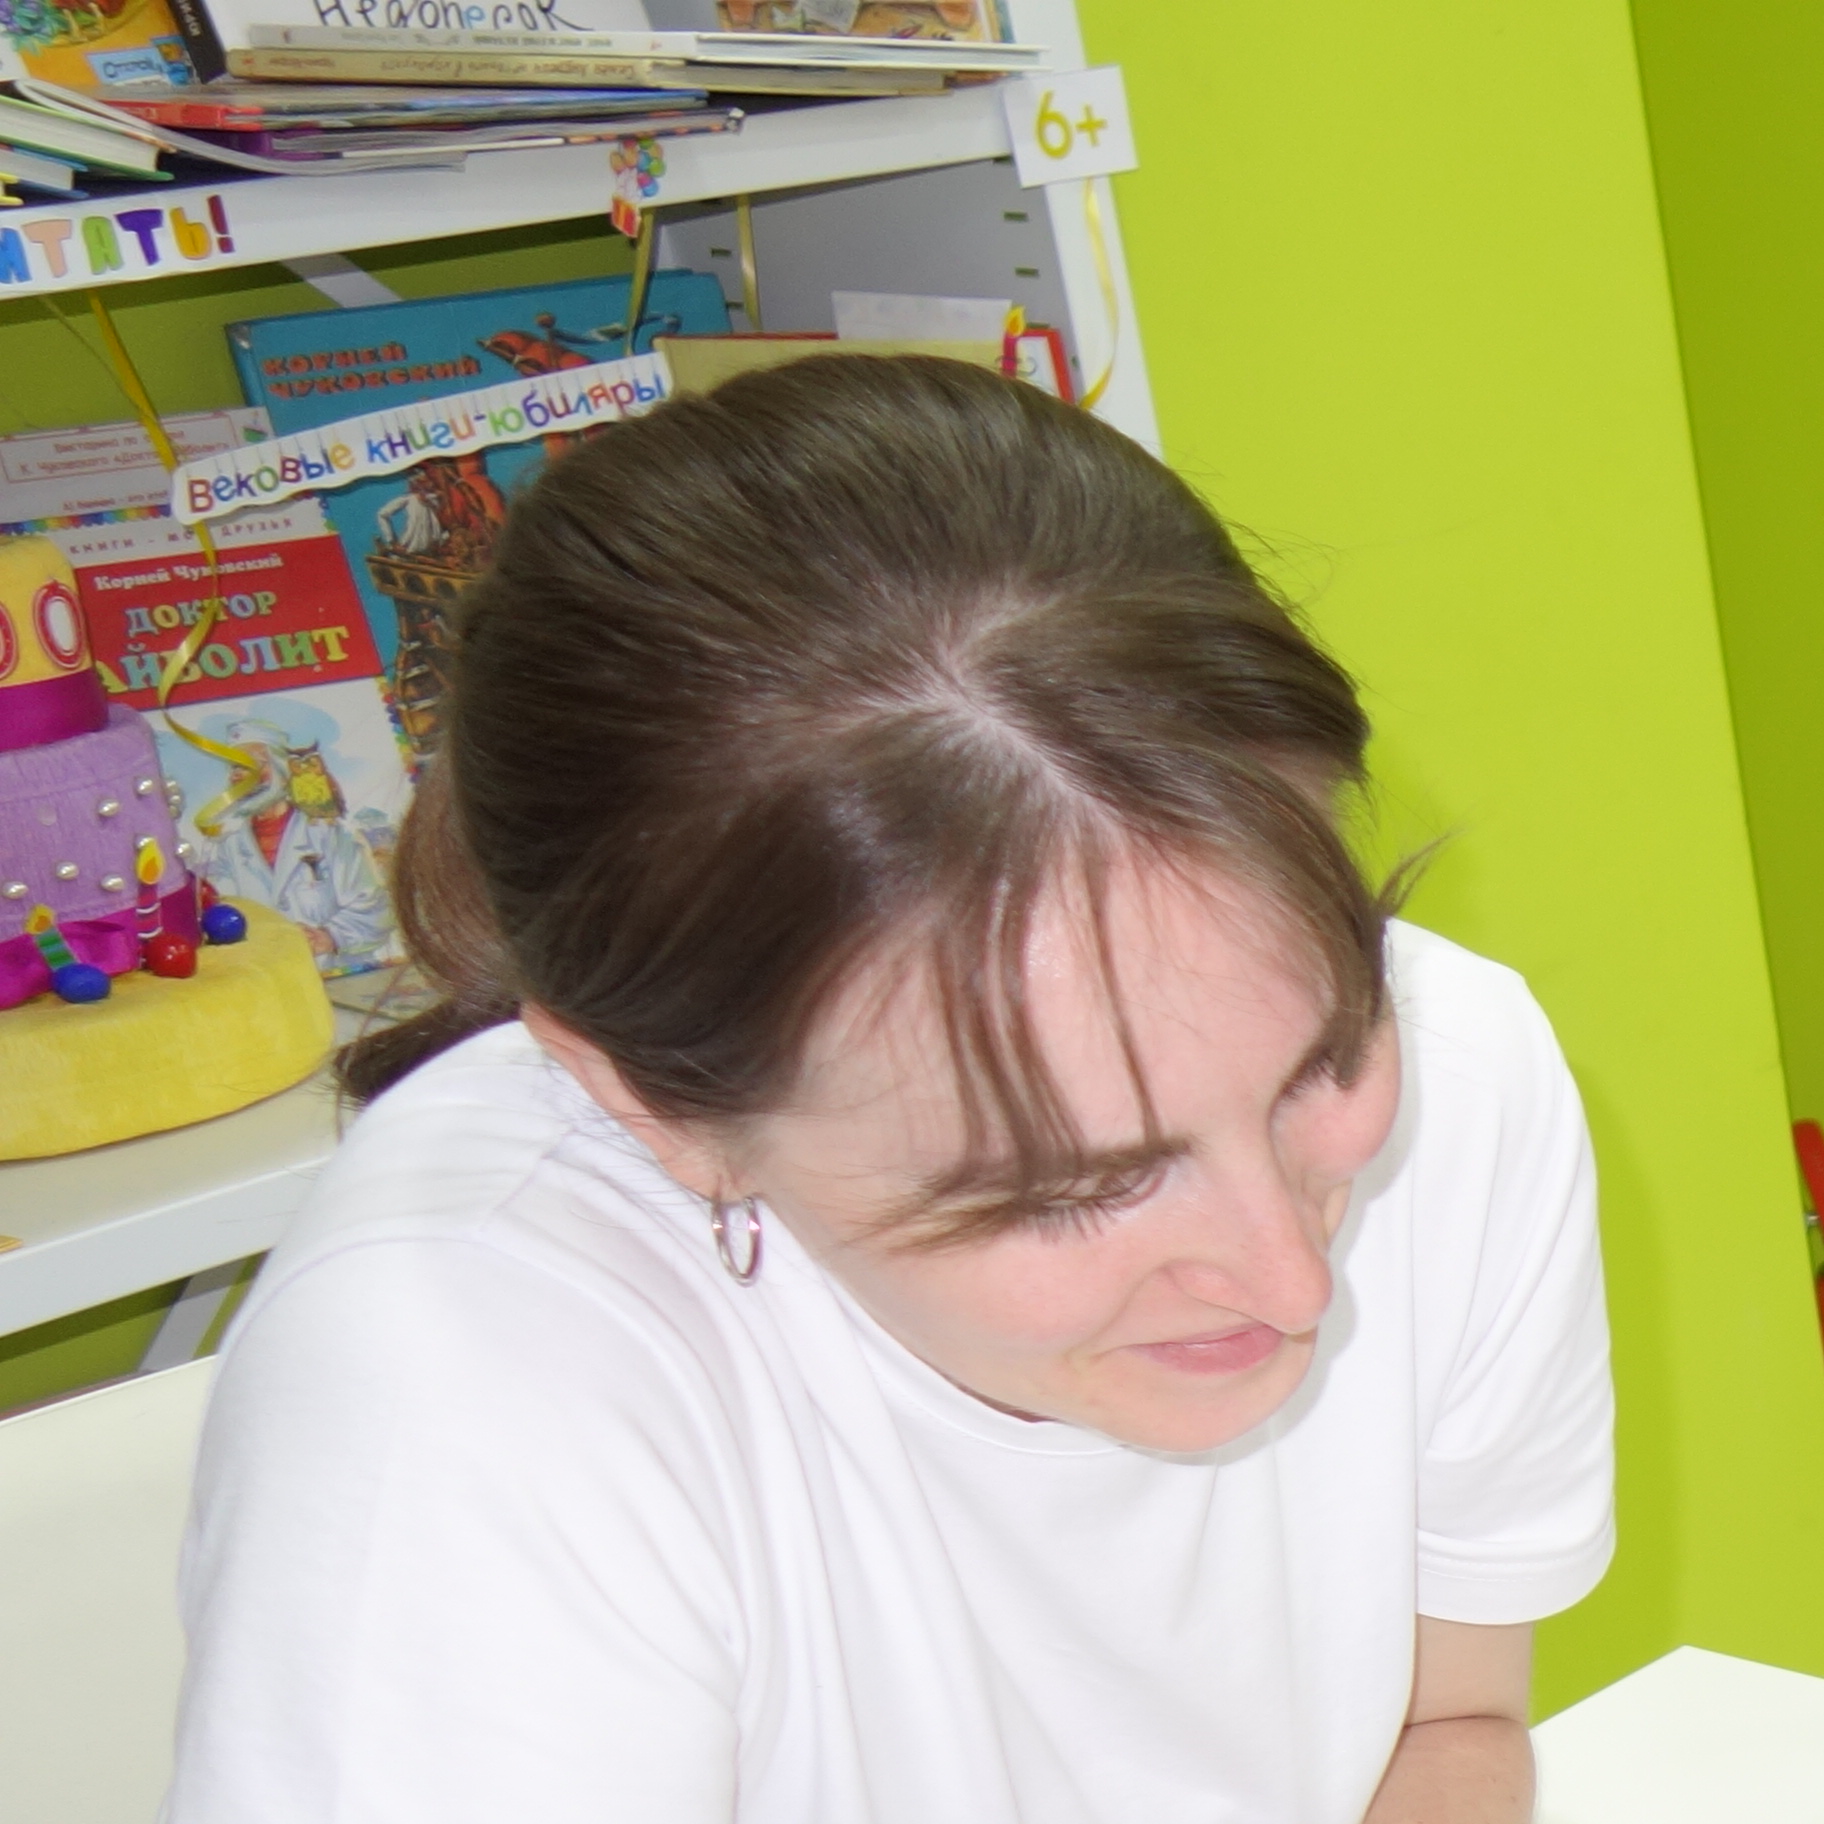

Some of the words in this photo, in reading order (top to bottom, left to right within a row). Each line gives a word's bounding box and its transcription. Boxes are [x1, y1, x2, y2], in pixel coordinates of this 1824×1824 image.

[1034, 90, 1108, 159] 6+
[0, 194, 235, 284] ИТАТЬ!
[261, 341, 407, 376] КОРНЕЙ
[267, 356, 482, 399] ЧУКОВСКИЙ
[187, 441, 356, 513] Вековые
[366, 373, 666, 467] книги-юбиляры
[69, 539, 135, 554] КНИГИ
[168, 531, 196, 543] МО
[221, 519, 293, 537] ДРУЗЬЯ
[94, 568, 172, 592] Корней
[172, 553, 284, 580] Чуковский
[124, 590, 278, 638] ДОКТОР
